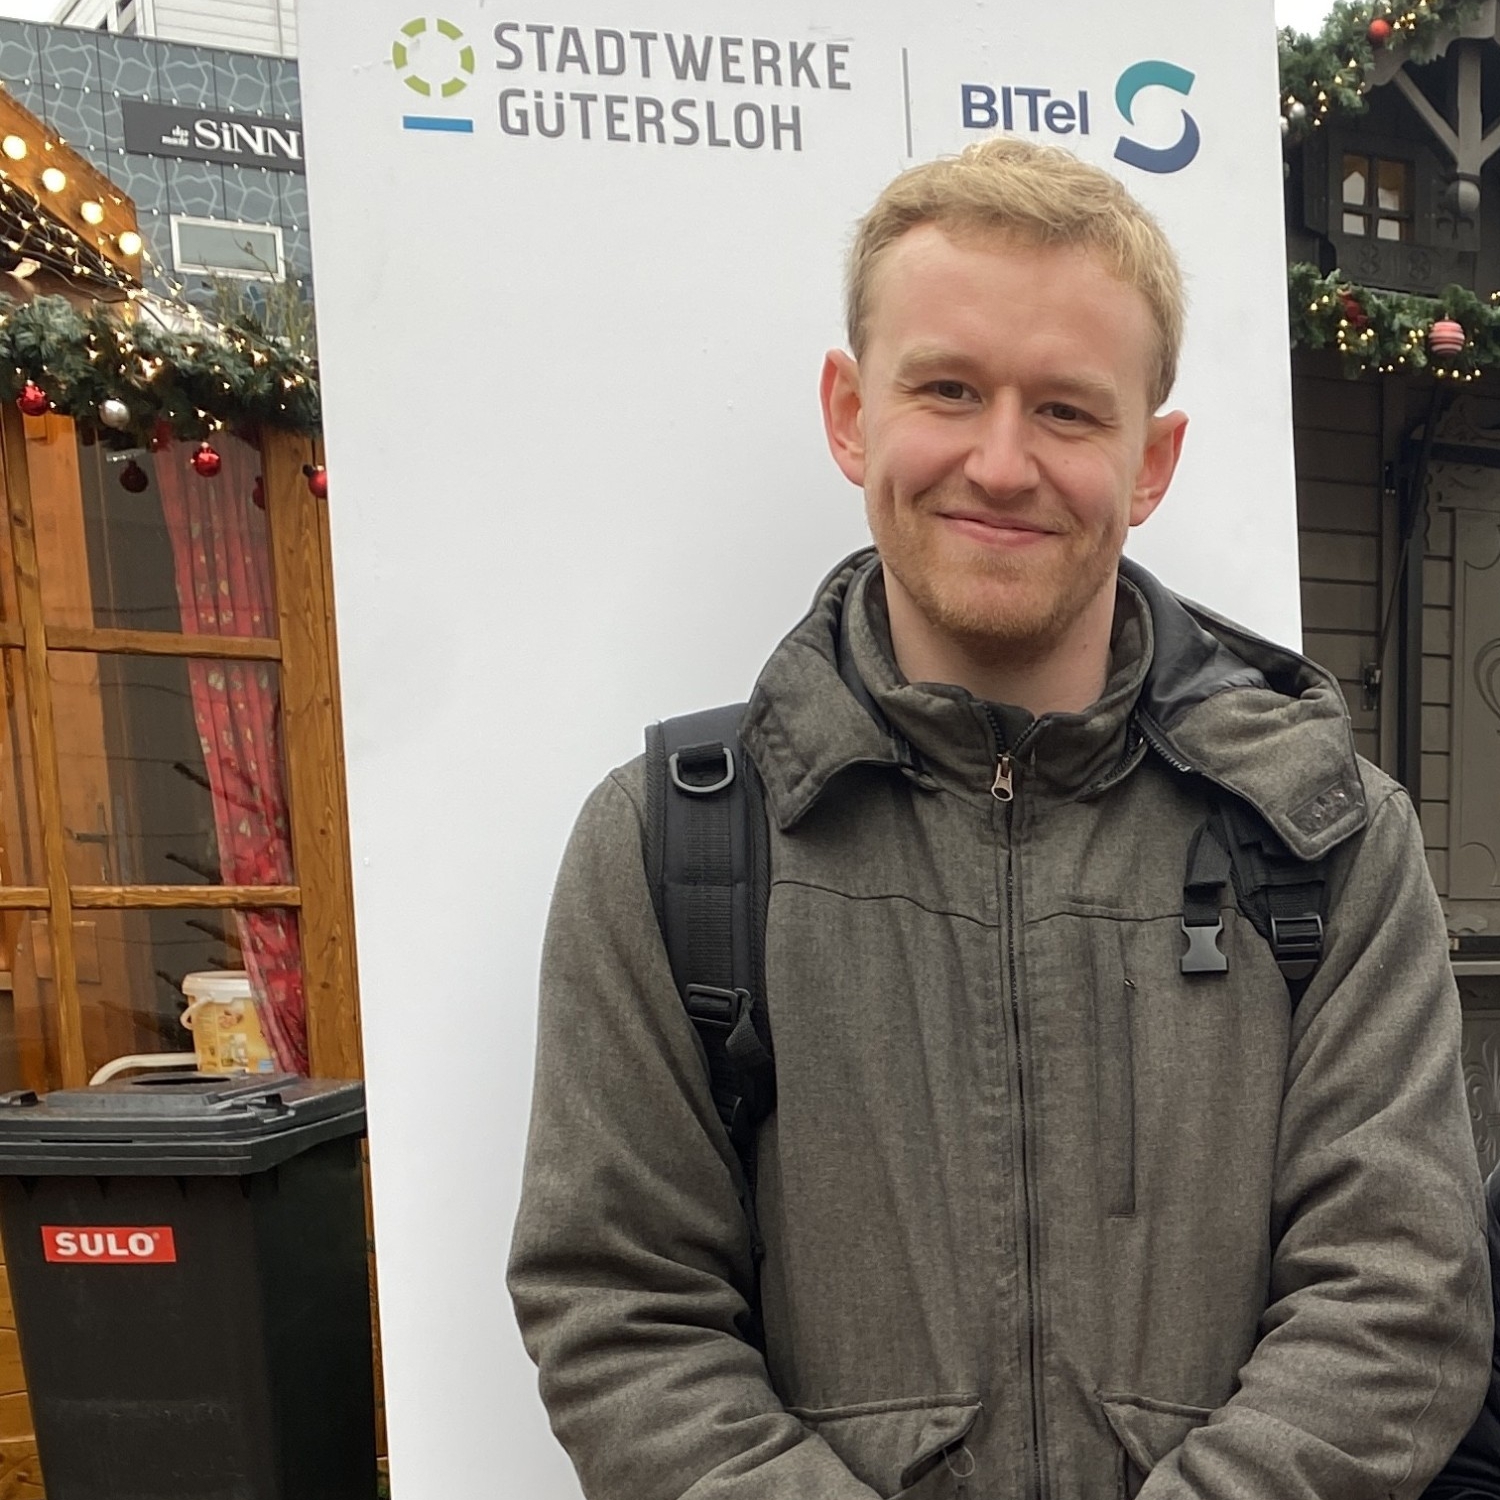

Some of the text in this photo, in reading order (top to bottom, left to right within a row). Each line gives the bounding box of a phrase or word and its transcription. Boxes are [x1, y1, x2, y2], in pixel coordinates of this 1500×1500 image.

[493, 22, 1089, 136] STADTWERKE BITel
[498, 87, 803, 152] GÜTERSLOH
[55, 1232, 156, 1256] SULO
